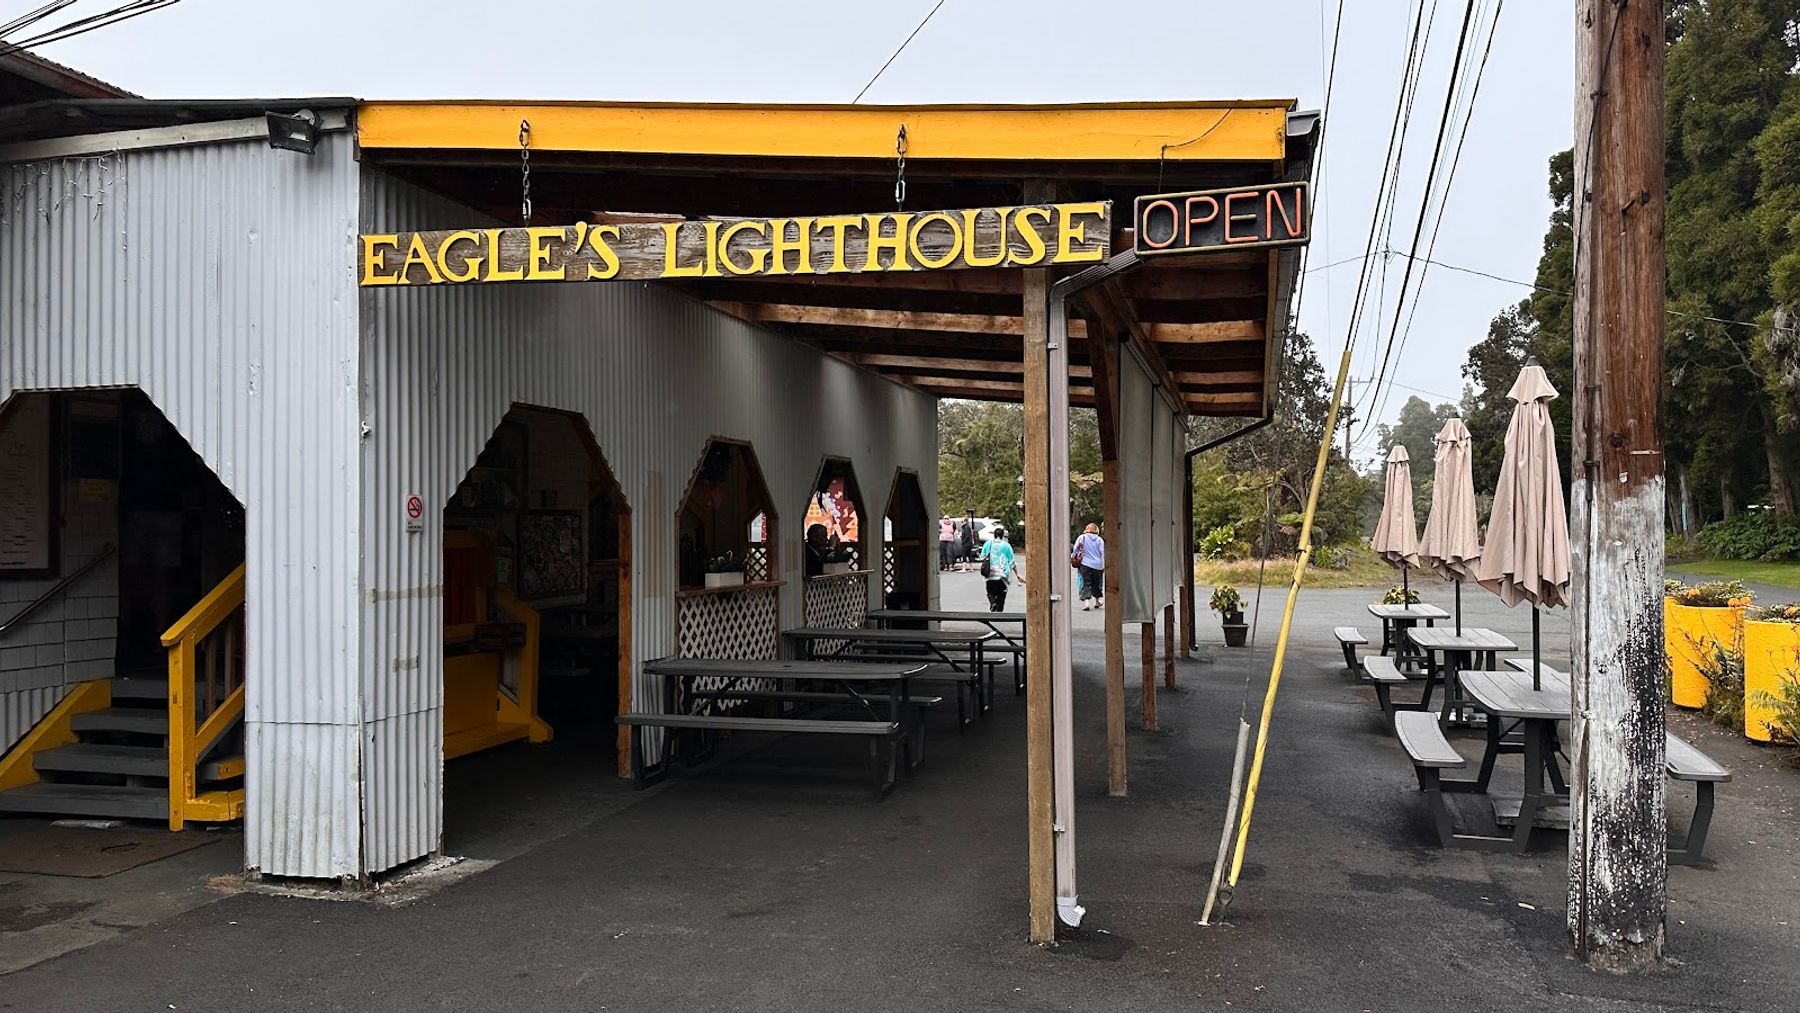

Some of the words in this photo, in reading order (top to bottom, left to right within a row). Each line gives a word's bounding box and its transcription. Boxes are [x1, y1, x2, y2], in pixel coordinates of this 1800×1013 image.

[360, 221, 621, 286] EAGLE'S
[660, 202, 1105, 279] LIGHTHOUSE
[1142, 187, 1302, 248] OPEN
